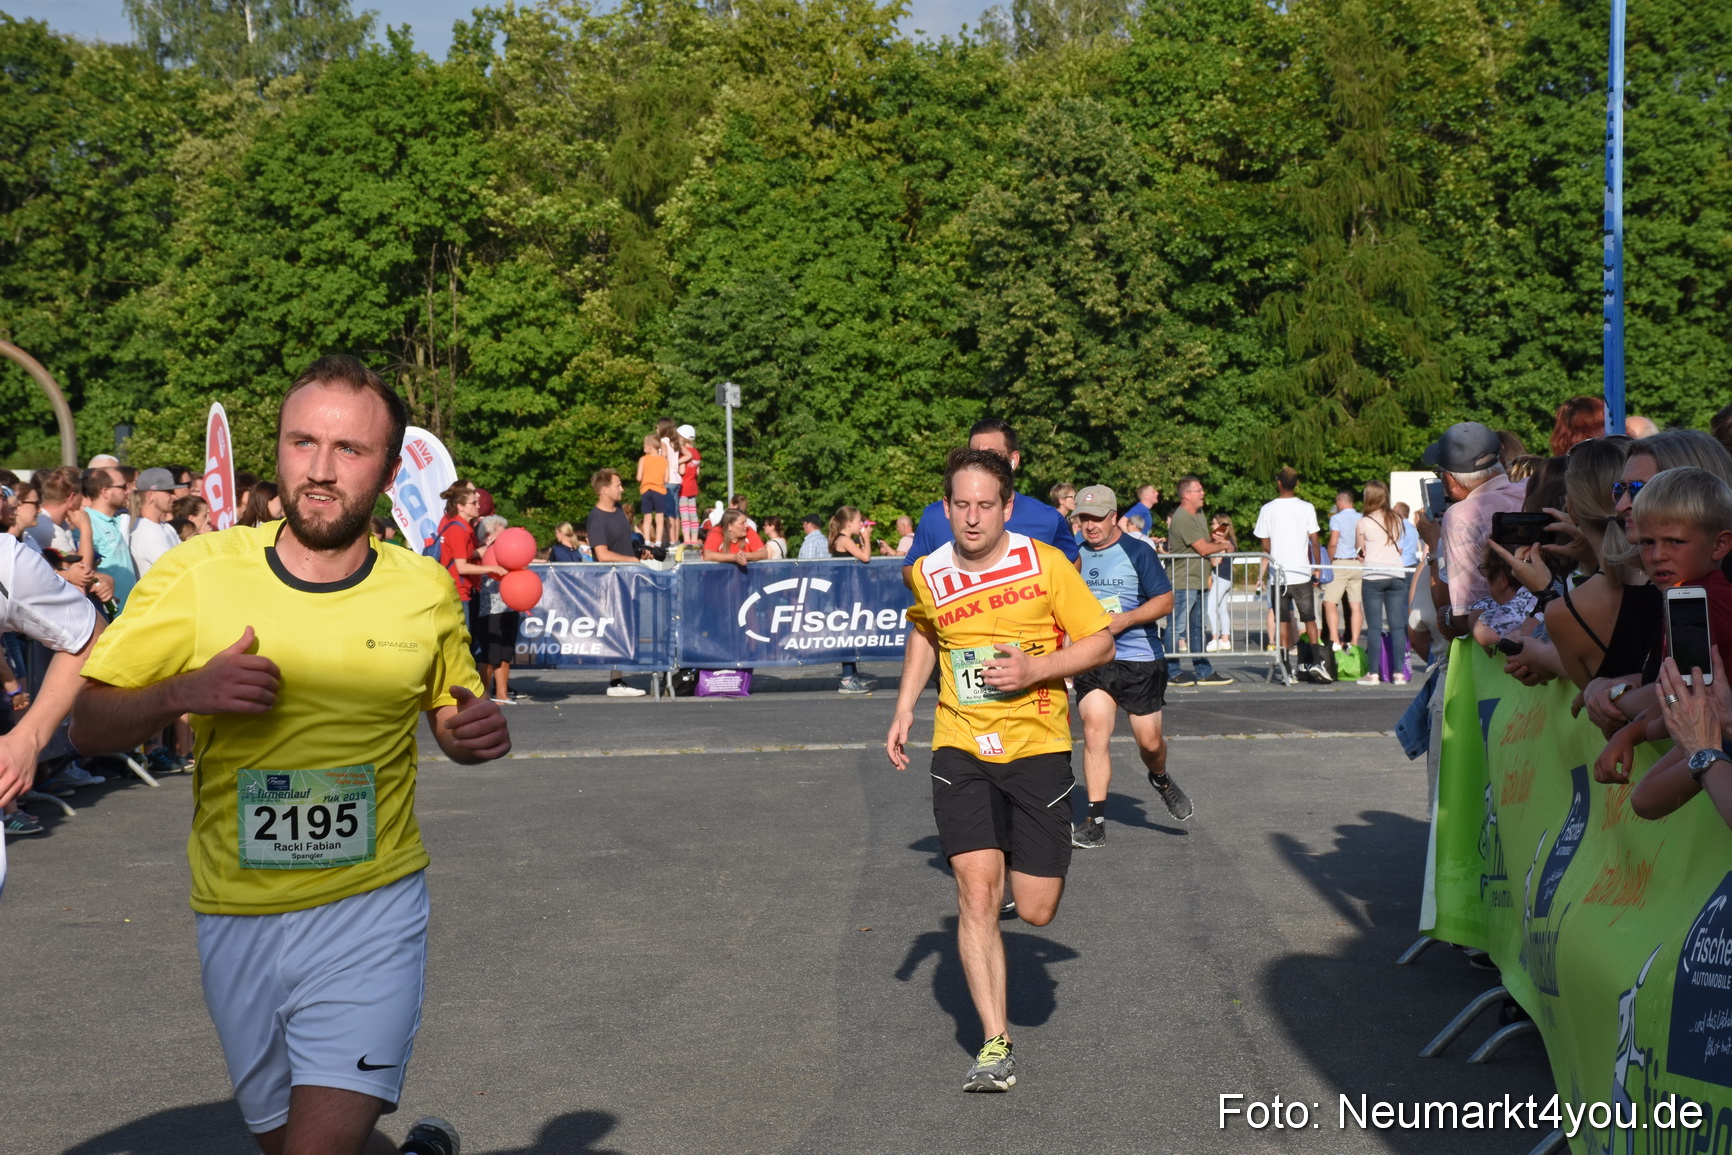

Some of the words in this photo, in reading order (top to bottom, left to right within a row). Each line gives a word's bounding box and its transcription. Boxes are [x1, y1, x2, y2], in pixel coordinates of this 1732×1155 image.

[937, 600, 984, 629] MAX
[988, 583, 1048, 610] BÖGL
[520, 609, 615, 638] cher
[770, 602, 908, 633] Fischer
[377, 640, 419, 649] SPANGLER
[515, 642, 602, 655] OMOBILE
[784, 634, 905, 650] AUTOMOBILE
[257, 788, 312, 799] firmenlauf
[343, 791, 367, 802] 2019
[254, 802, 358, 841] 2195
[274, 842, 303, 852] Rackl
[306, 841, 342, 851] Fabian
[291, 852, 324, 861] Spangler
[1690, 927, 1732, 967] Fische
[1691, 970, 1732, 990] AUTOMOBILE
